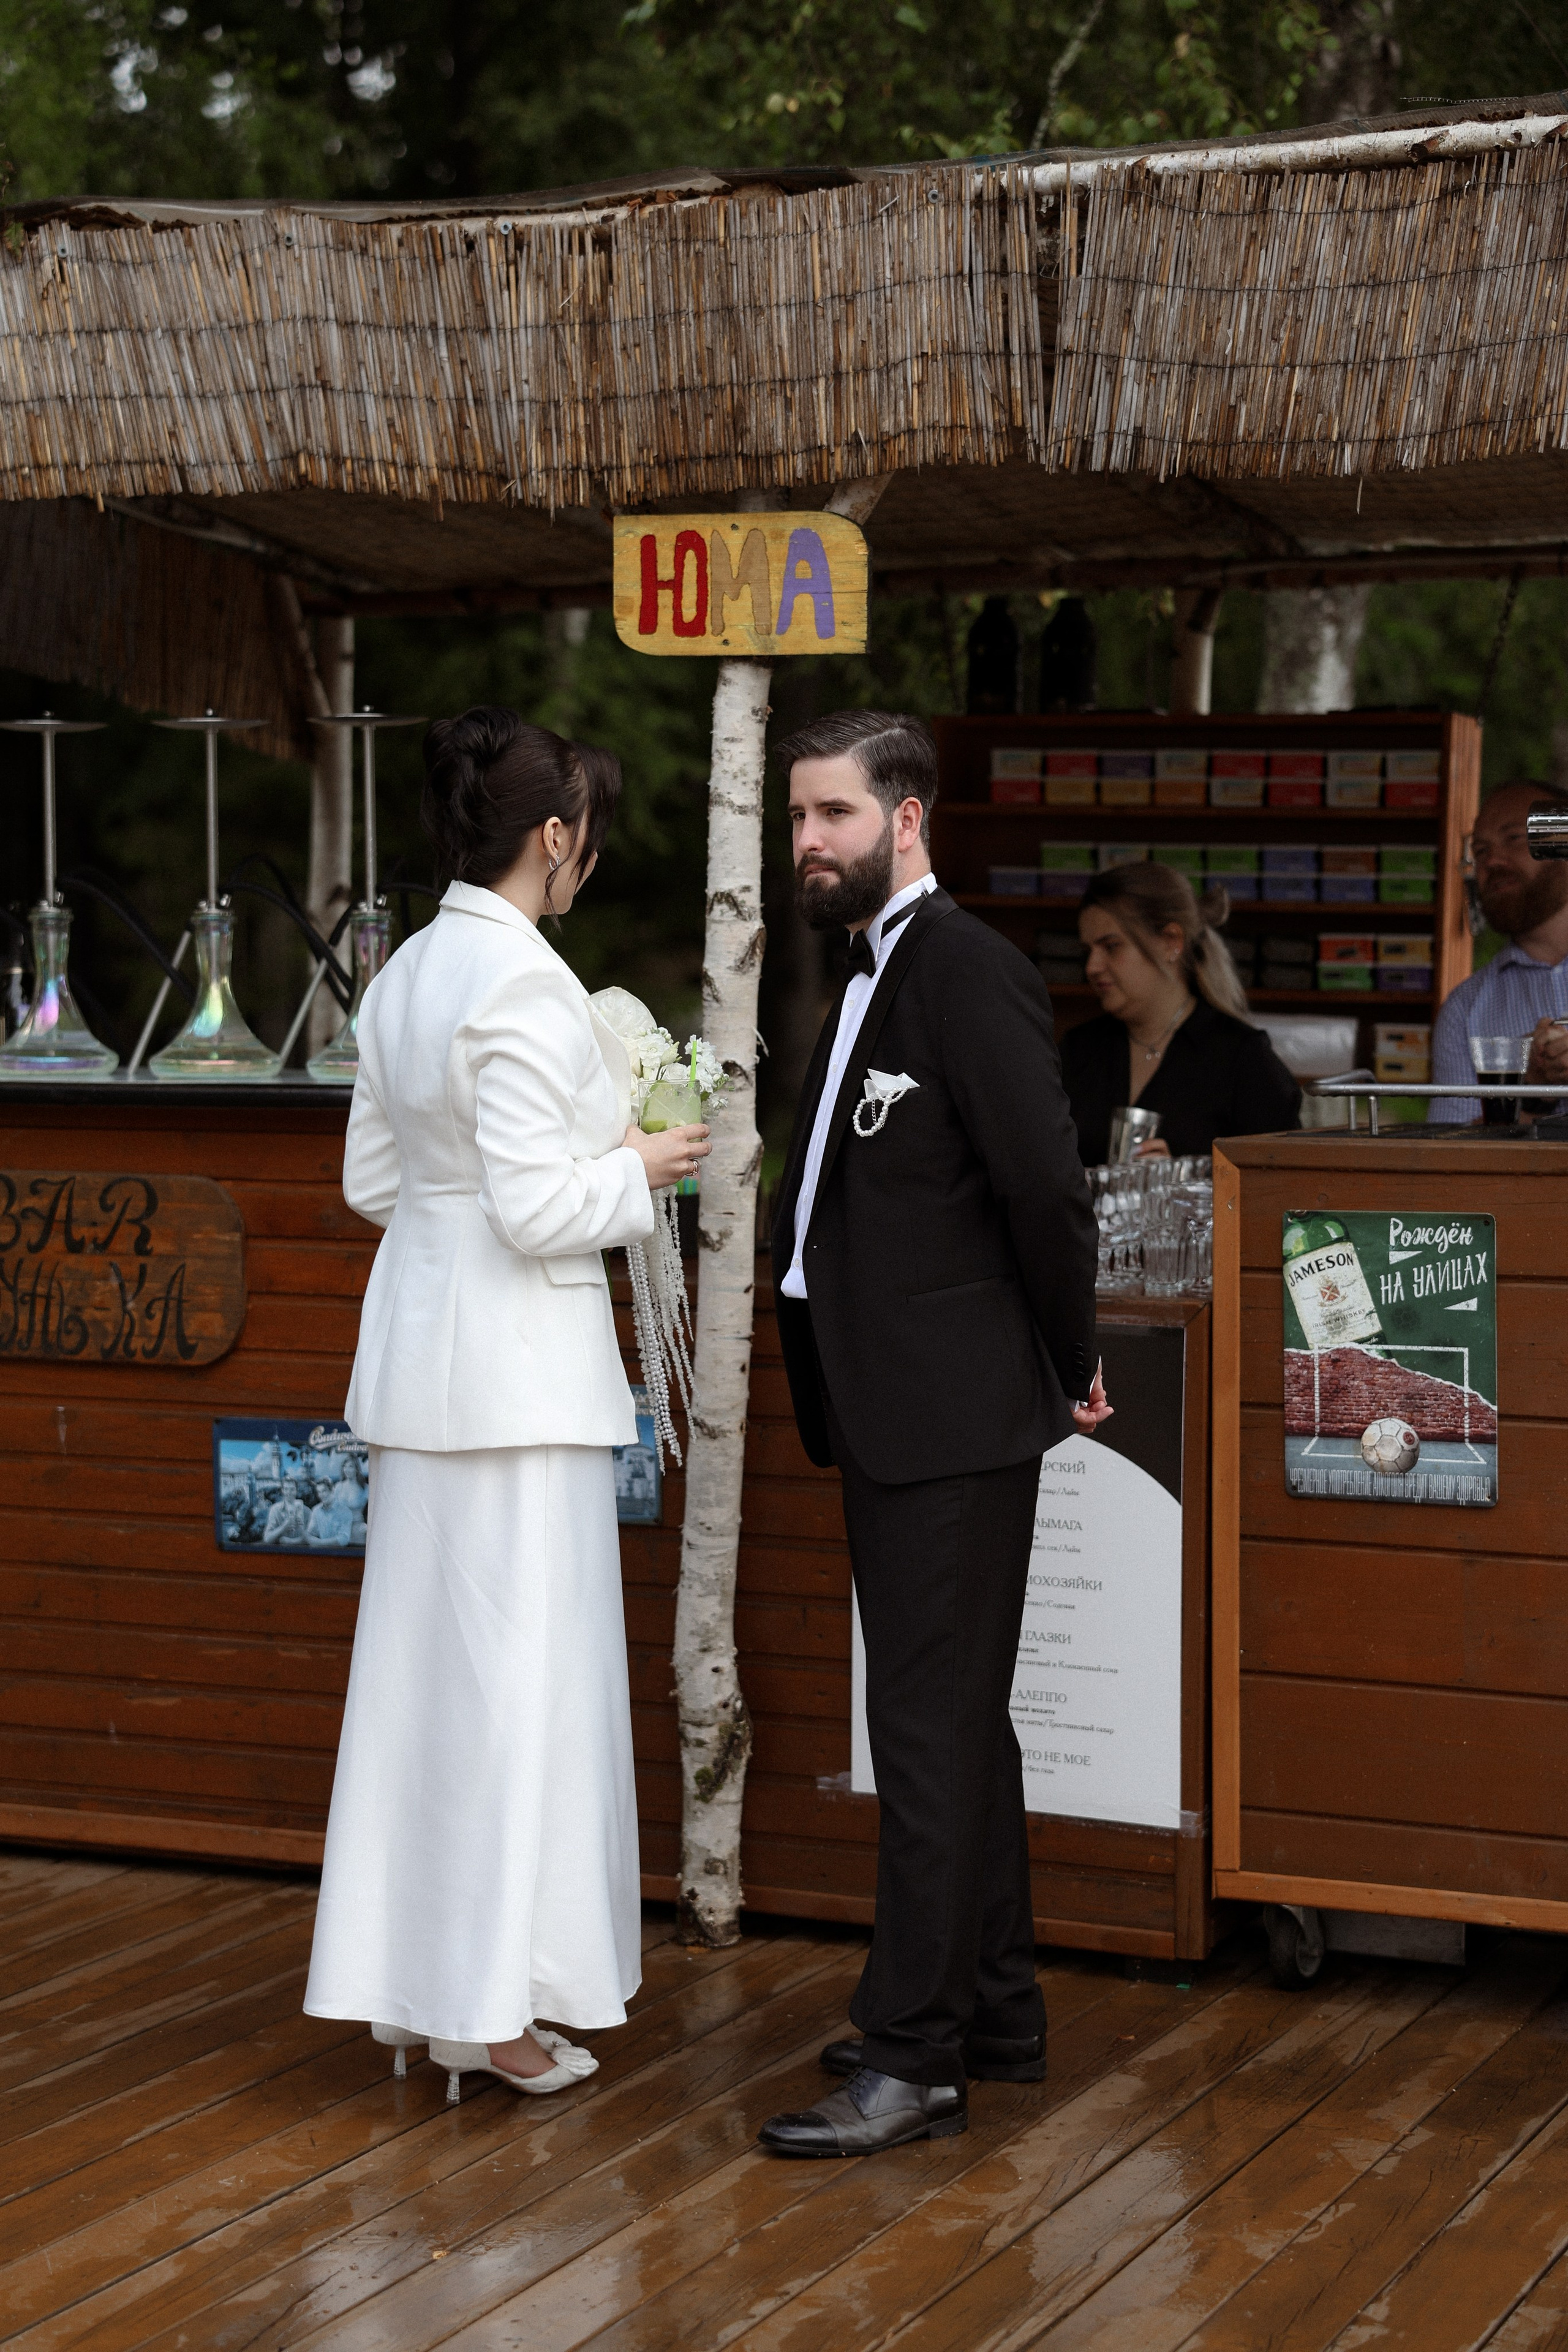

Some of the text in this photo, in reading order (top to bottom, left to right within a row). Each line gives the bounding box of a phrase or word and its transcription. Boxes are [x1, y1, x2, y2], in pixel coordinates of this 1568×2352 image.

[1389, 1217, 1474, 1254] Рождён
[1289, 1253, 1354, 1287] JAMESON
[1380, 1251, 1487, 1305] НА УЛИЦАХ
[1312, 1319, 1331, 1329] IRISH
[1333, 1308, 1366, 1323] WHISKEY
[1041, 1460, 1085, 1474] РСКИЙ
[1289, 1468, 1490, 1506] ЧРЕЗМЕРНОЕ УПОТРЕБЛЕНИЕ АЛКОГОЛЯ ВРЕДИТ ВАШЕМУ ЗДОРОВЬЮ
[1025, 1630, 1071, 1644] ГЛАЗКИ
[1011, 1689, 1068, 1703] -АЛЕППО
[1044, 1751, 1061, 1763] НЕ
[1063, 1753, 1091, 1766] МОЕ
